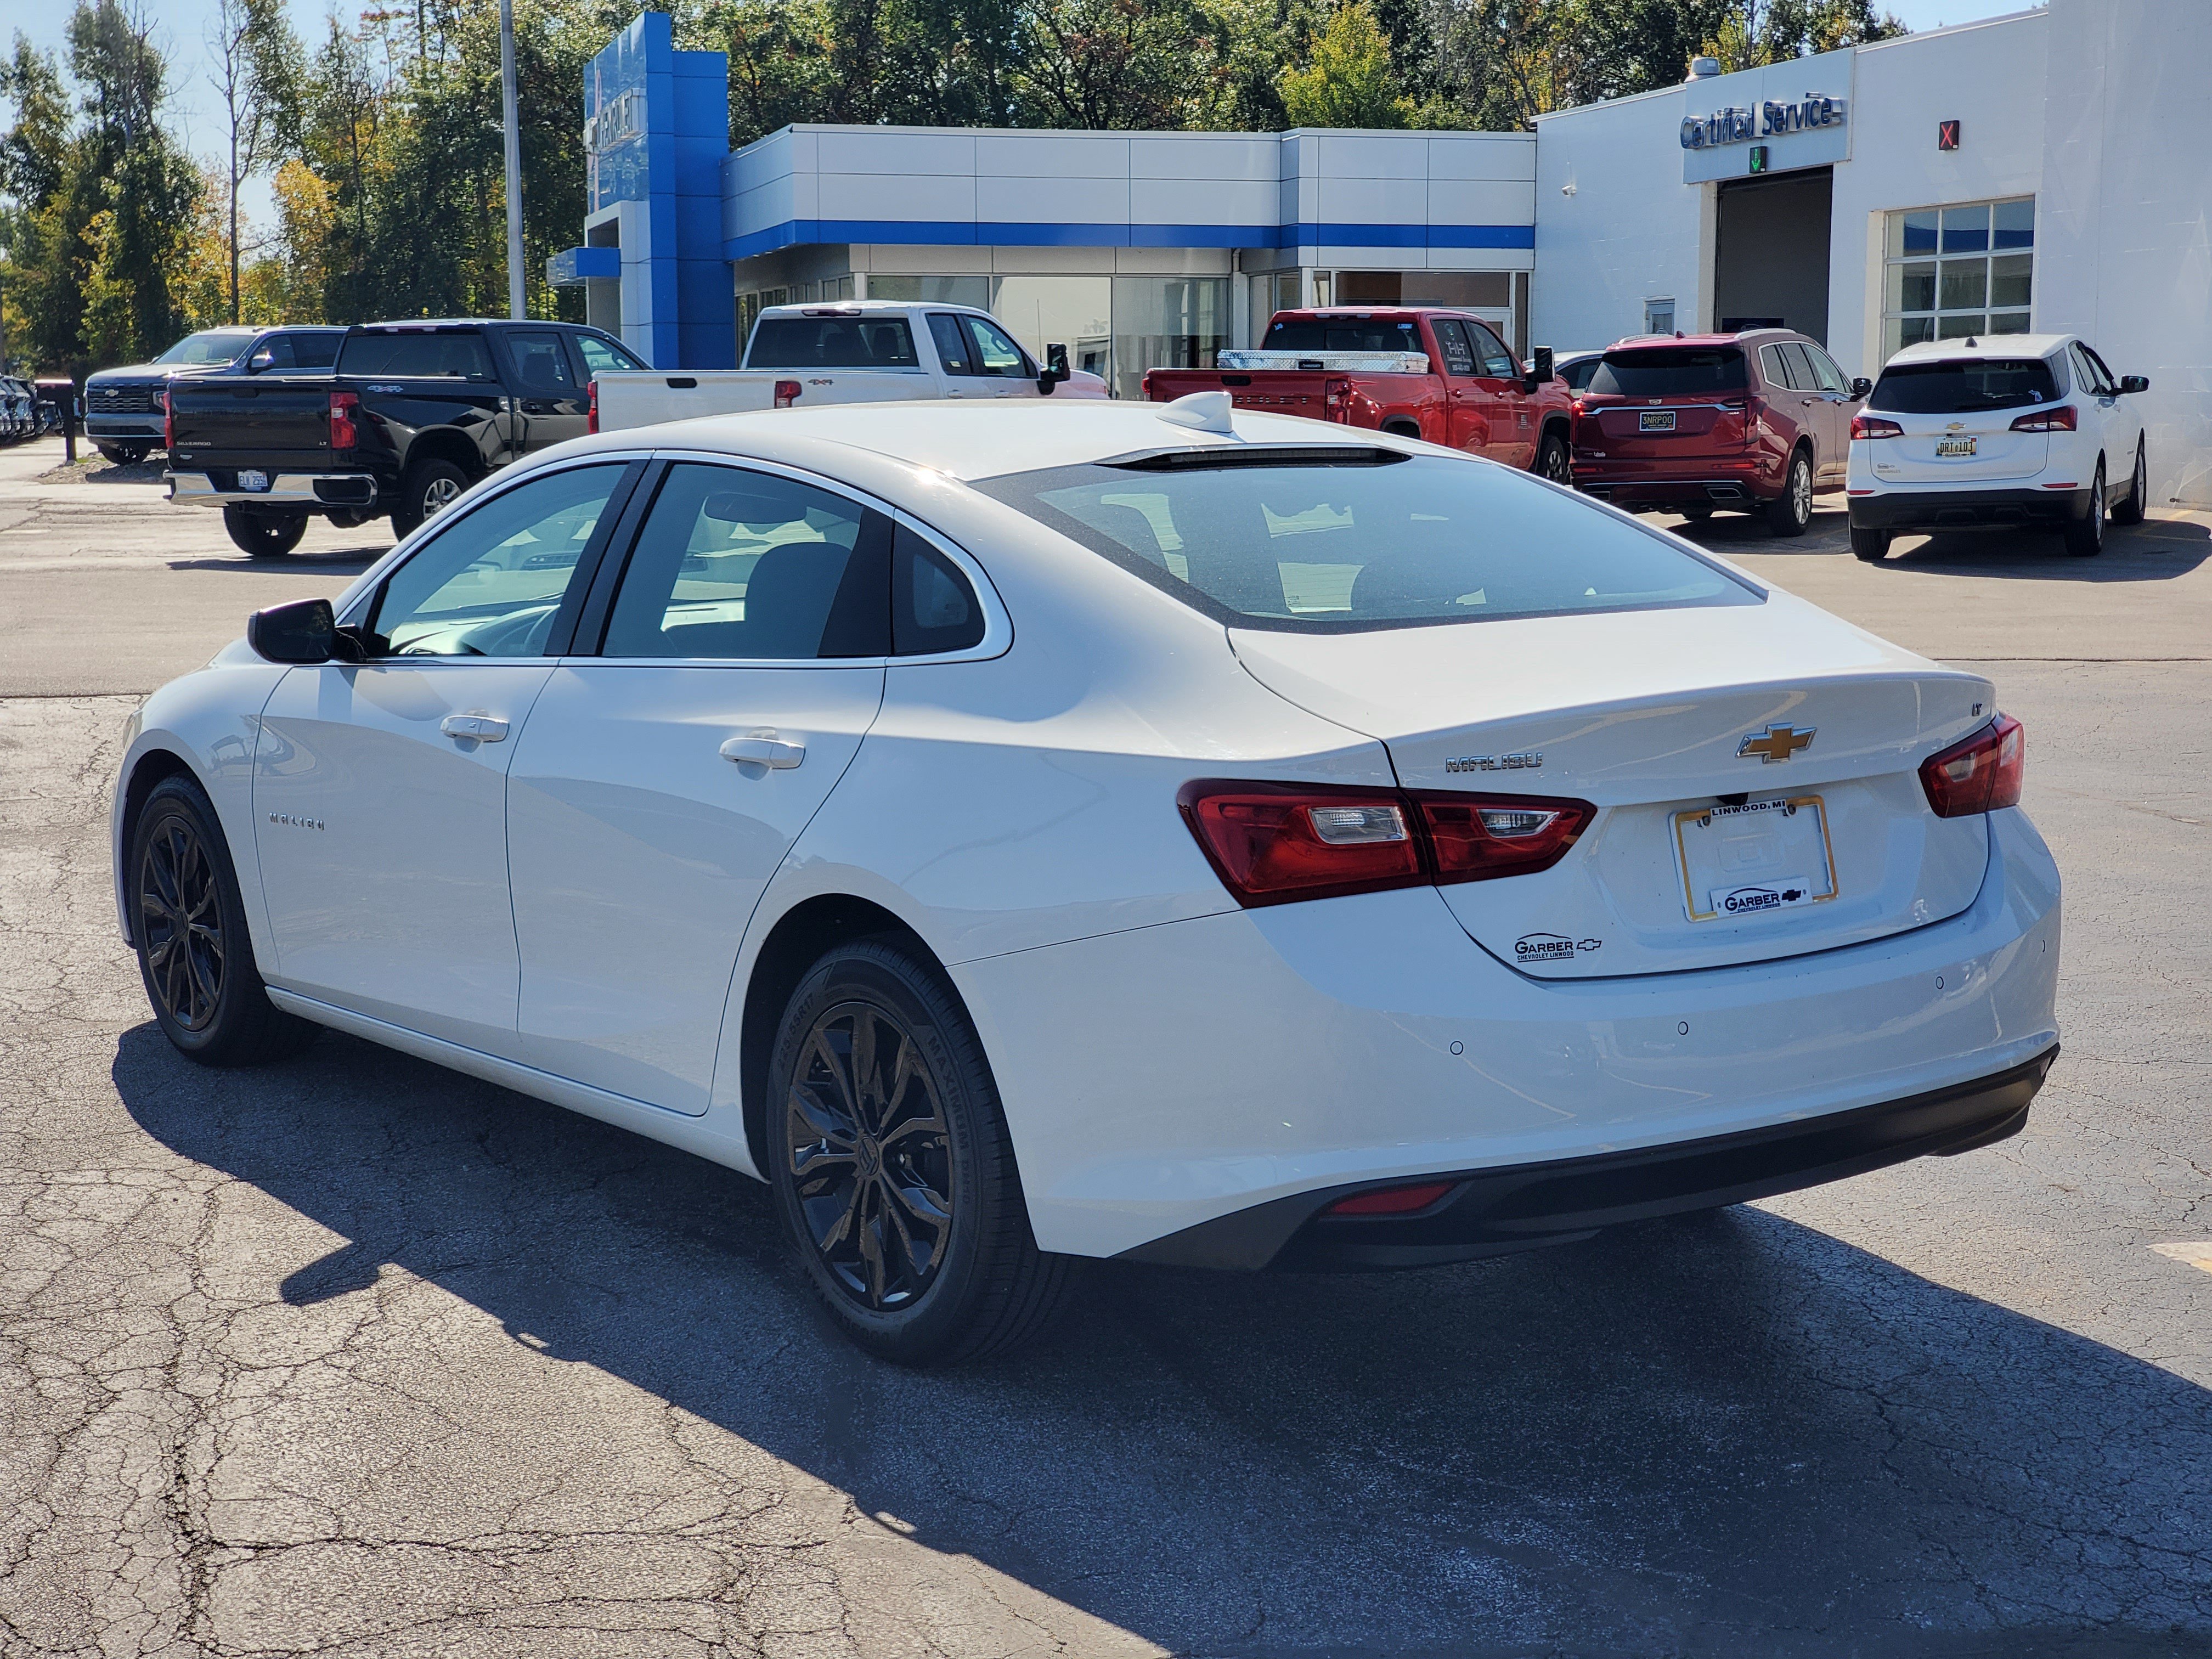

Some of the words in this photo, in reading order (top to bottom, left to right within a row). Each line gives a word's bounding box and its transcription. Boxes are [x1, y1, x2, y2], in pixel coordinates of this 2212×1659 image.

[1680, 107, 1758, 149] Certified
[1762, 92, 1835, 136] Service
[1940, 442, 1954, 453] DRT
[1959, 441, 1973, 452] 103
[1446, 752, 1543, 773] MALIBU
[269, 812, 324, 831] MALIBU
[1724, 893, 1780, 911] GARBER
[1514, 941, 1573, 955] GARBER
[1517, 952, 1548, 961] CHEVROLET
[926, 1031, 970, 1150] MAXIMUM
